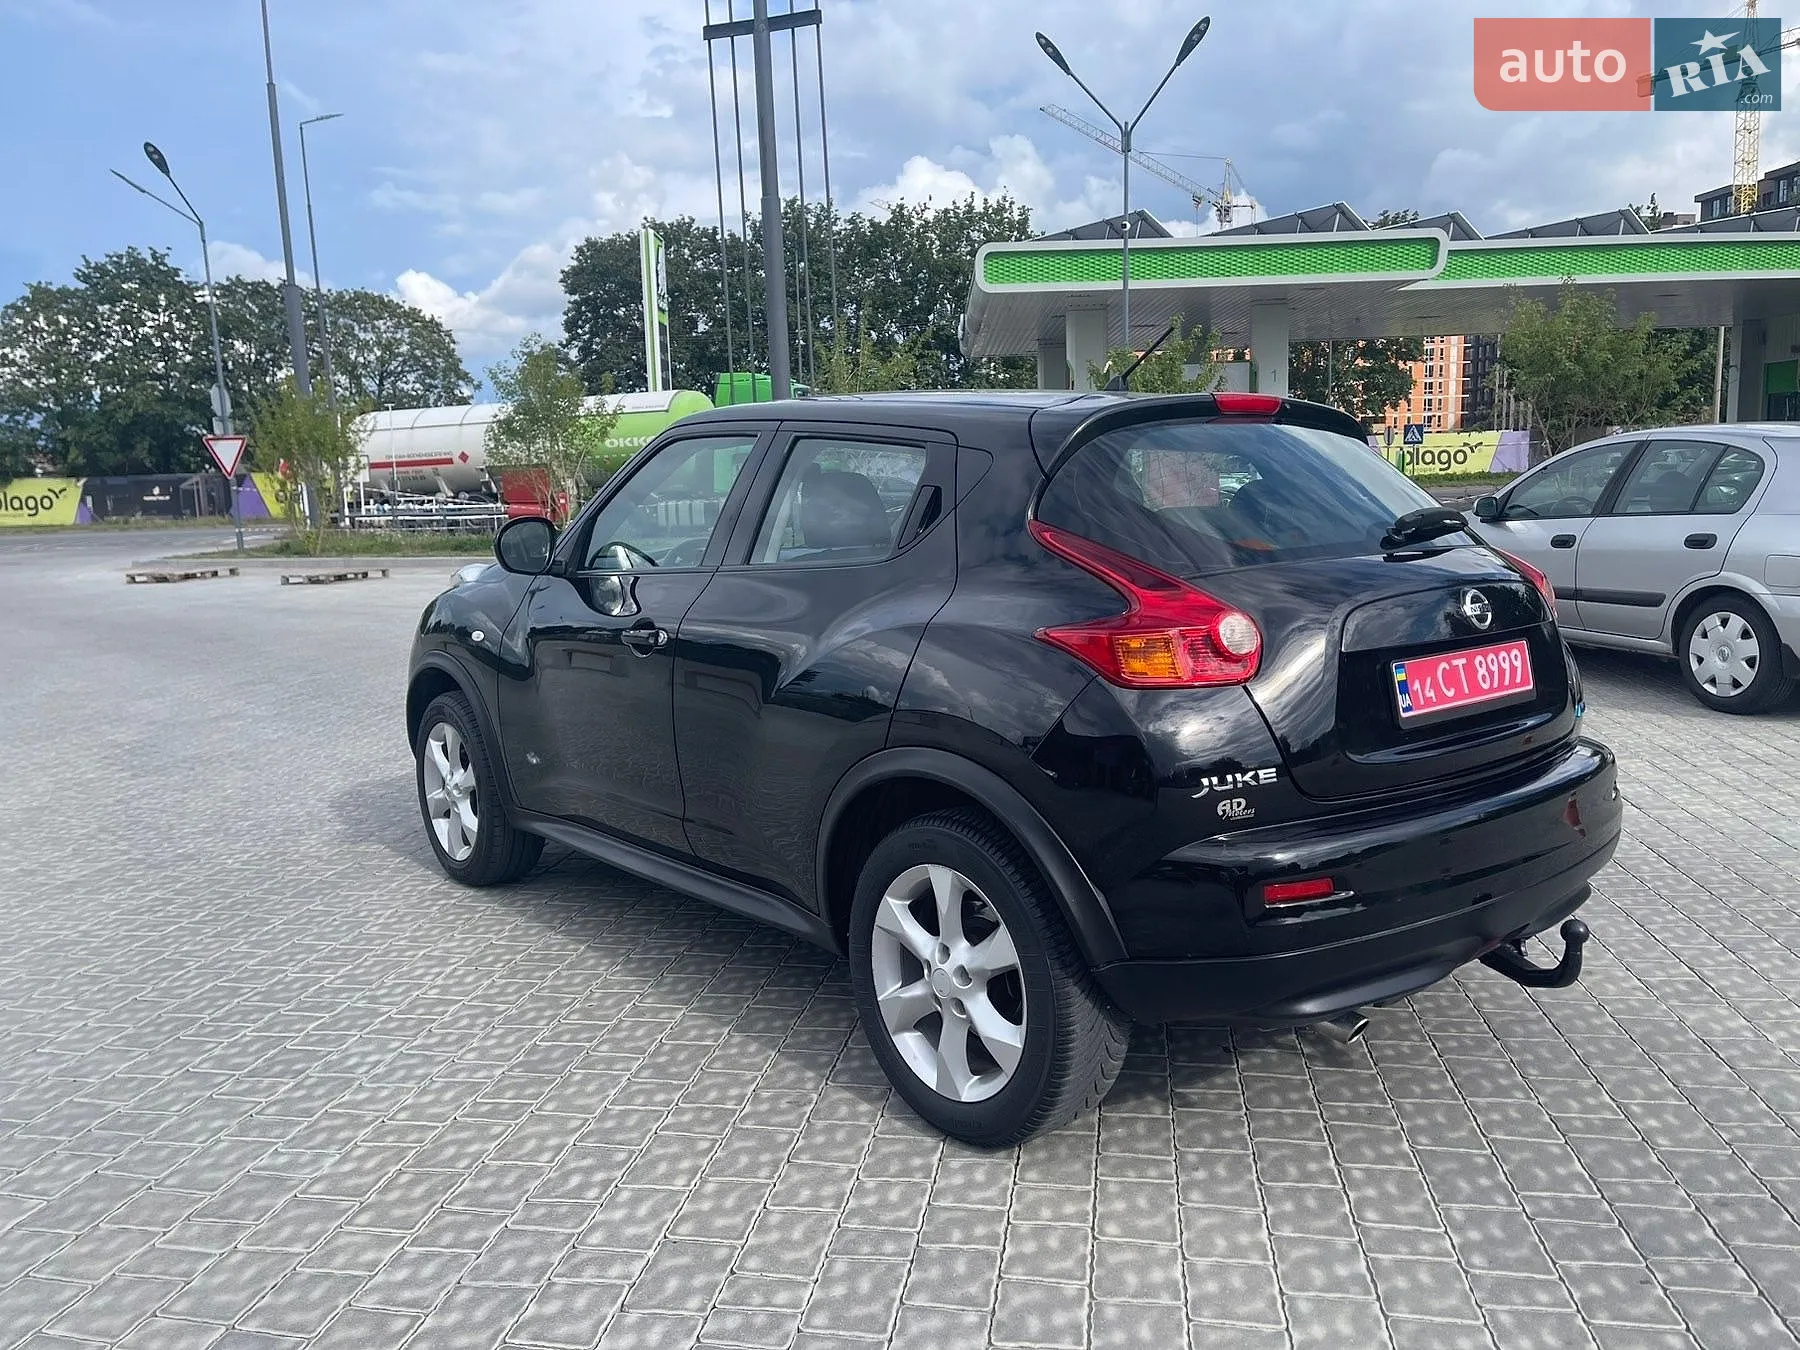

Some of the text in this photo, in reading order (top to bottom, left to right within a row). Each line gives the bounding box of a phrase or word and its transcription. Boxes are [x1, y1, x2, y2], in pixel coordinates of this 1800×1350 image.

[0, 491, 53, 517] lago
[1474, 648, 1523, 690] 8999
[1399, 693, 1412, 708] UA
[1191, 767, 1278, 799] JUKE
